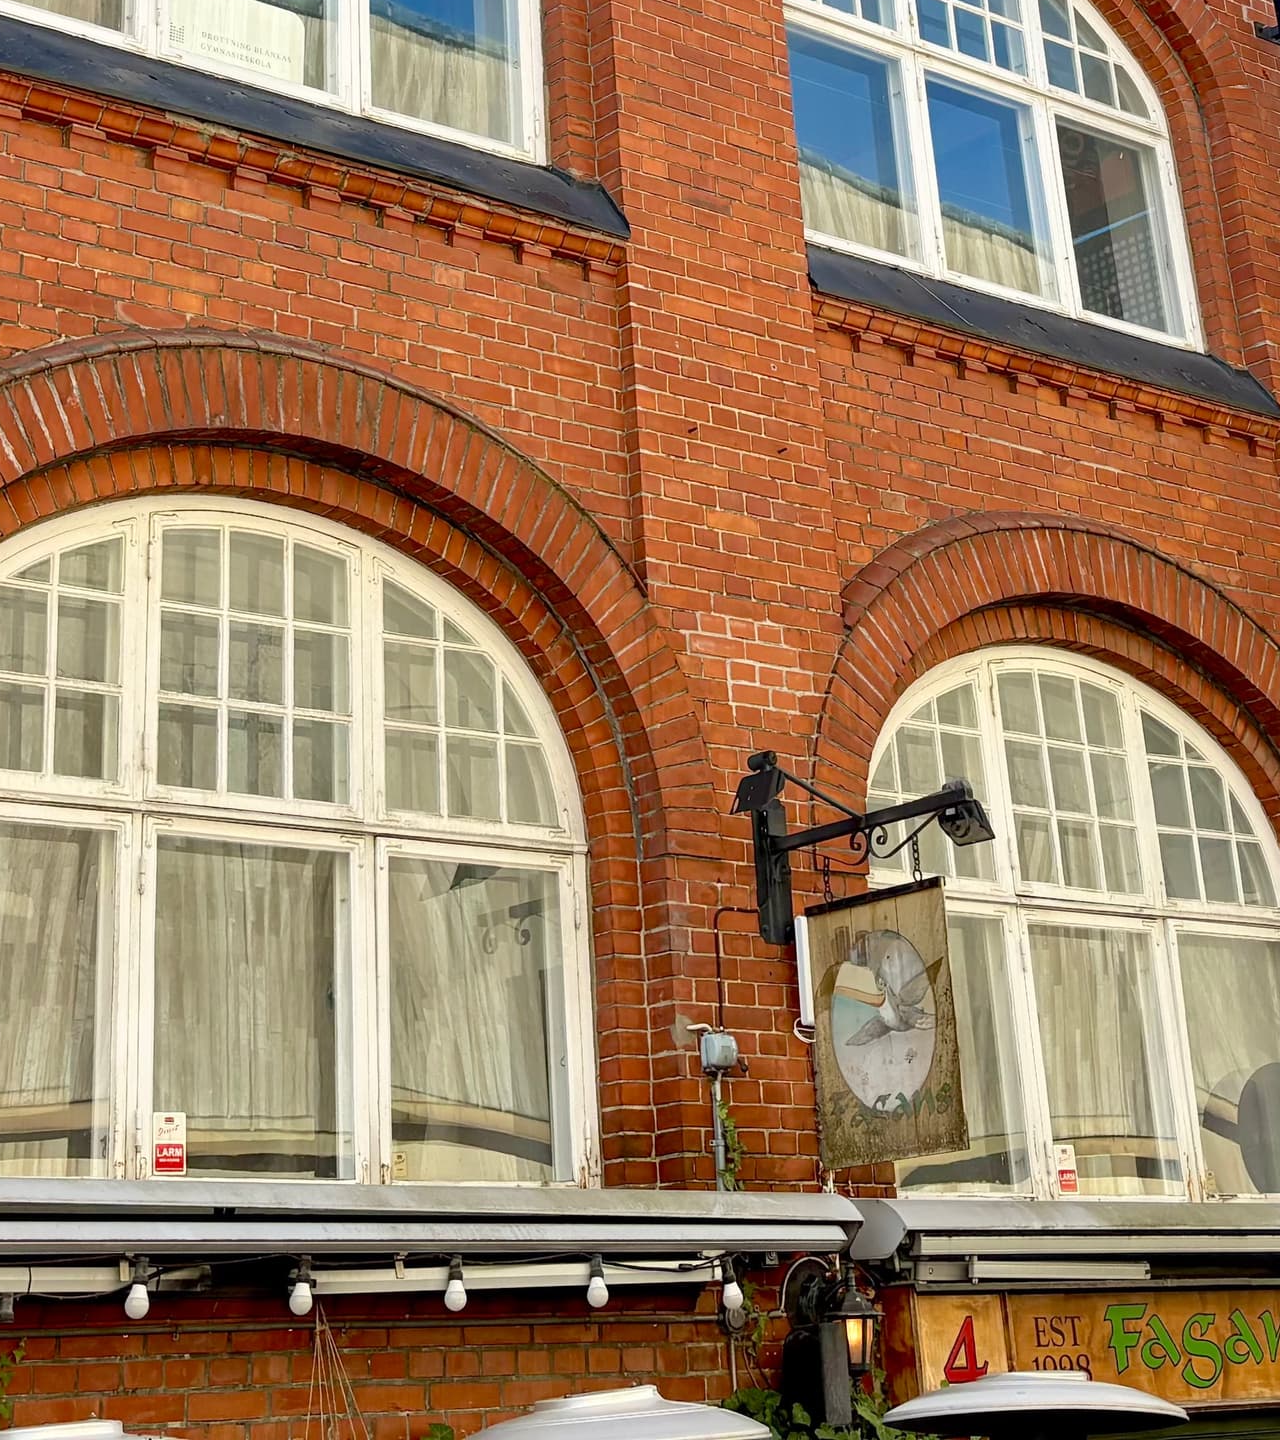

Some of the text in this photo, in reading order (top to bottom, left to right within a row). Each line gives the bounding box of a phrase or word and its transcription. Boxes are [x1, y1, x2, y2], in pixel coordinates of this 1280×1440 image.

[201, 31, 252, 52] DROTTNING
[156, 1147, 183, 1157] LARM
[1032, 1315, 1082, 1348] EST
[942, 1315, 989, 1384] 4
